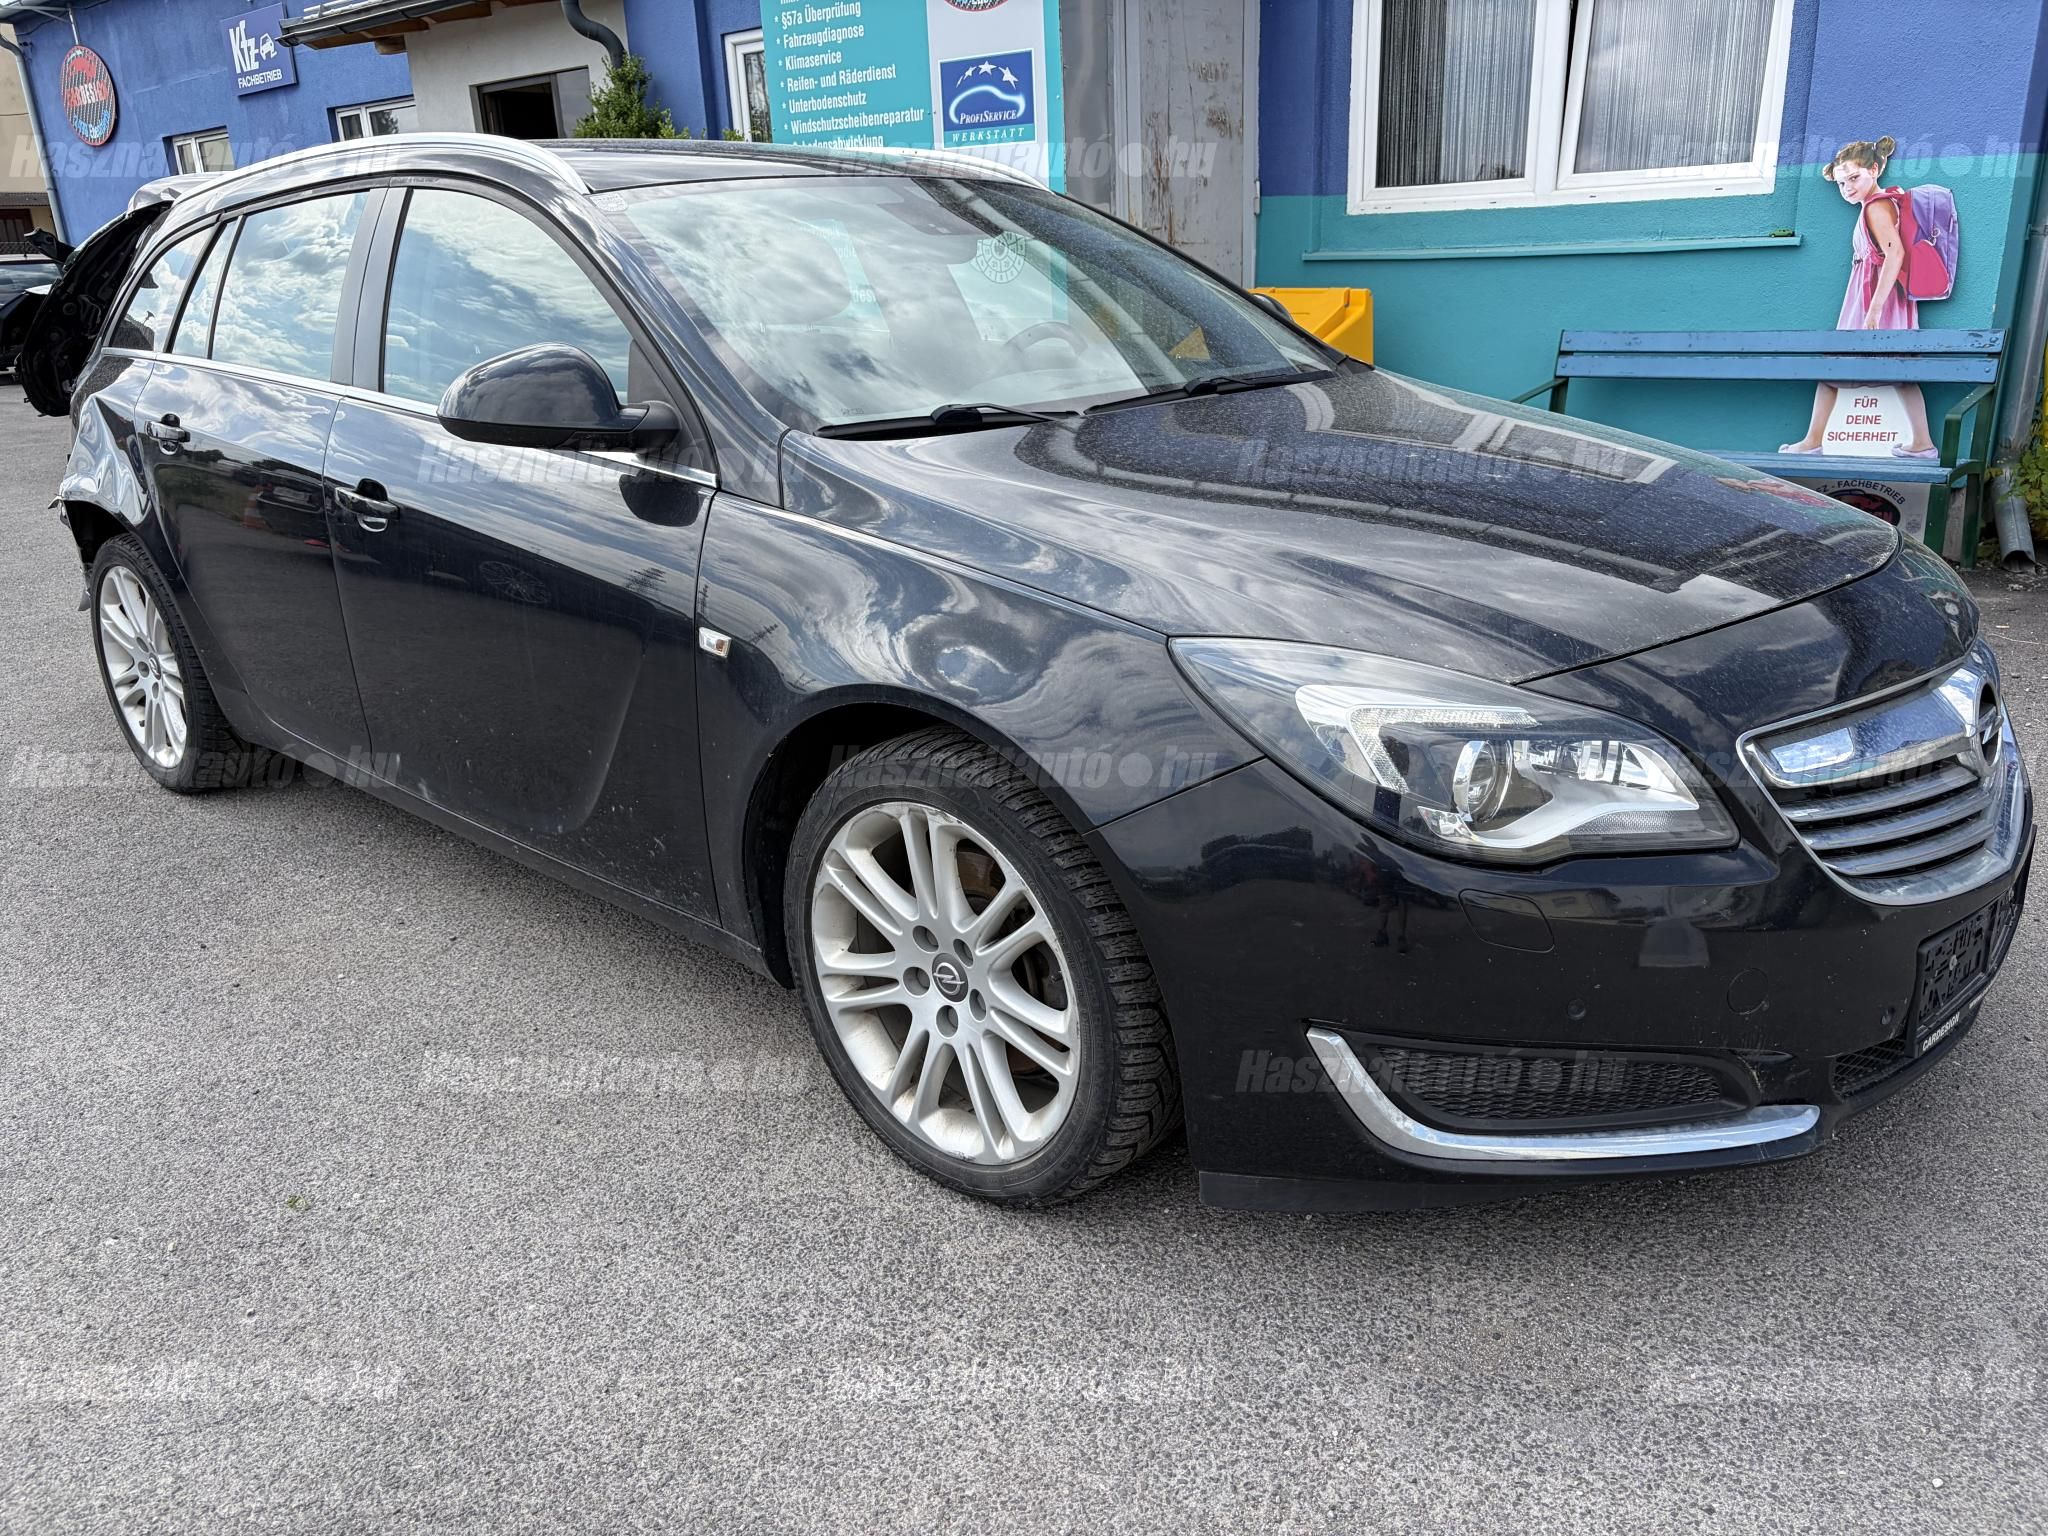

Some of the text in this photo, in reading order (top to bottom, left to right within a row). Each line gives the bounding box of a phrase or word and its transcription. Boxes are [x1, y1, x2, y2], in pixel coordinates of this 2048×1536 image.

[781, 1, 861, 30] §57a Überprüfung
[229, 20, 259, 74] Kfz
[783, 24, 864, 48] Fahrzeugdiagnose
[785, 50, 842, 71] Klimaservice
[237, 69, 282, 88] FACHBETRIEB
[787, 64, 896, 93] Reifen- und Räderdienst
[789, 91, 867, 114] Unterbodenschutz
[790, 107, 925, 135] Windschutzscheibenreparatur
[793, 134, 884, 149] densabwicklung
[952, 127, 1024, 143] WERKSTATT
[1854, 396, 1878, 408] FÜR
[1846, 415, 1882, 425] DEINE
[1827, 432, 1899, 442] SICHERHEIT
[1837, 479, 1906, 505] FACHBETRIEB
[1922, 1011, 1961, 1051] CARDESIGN
